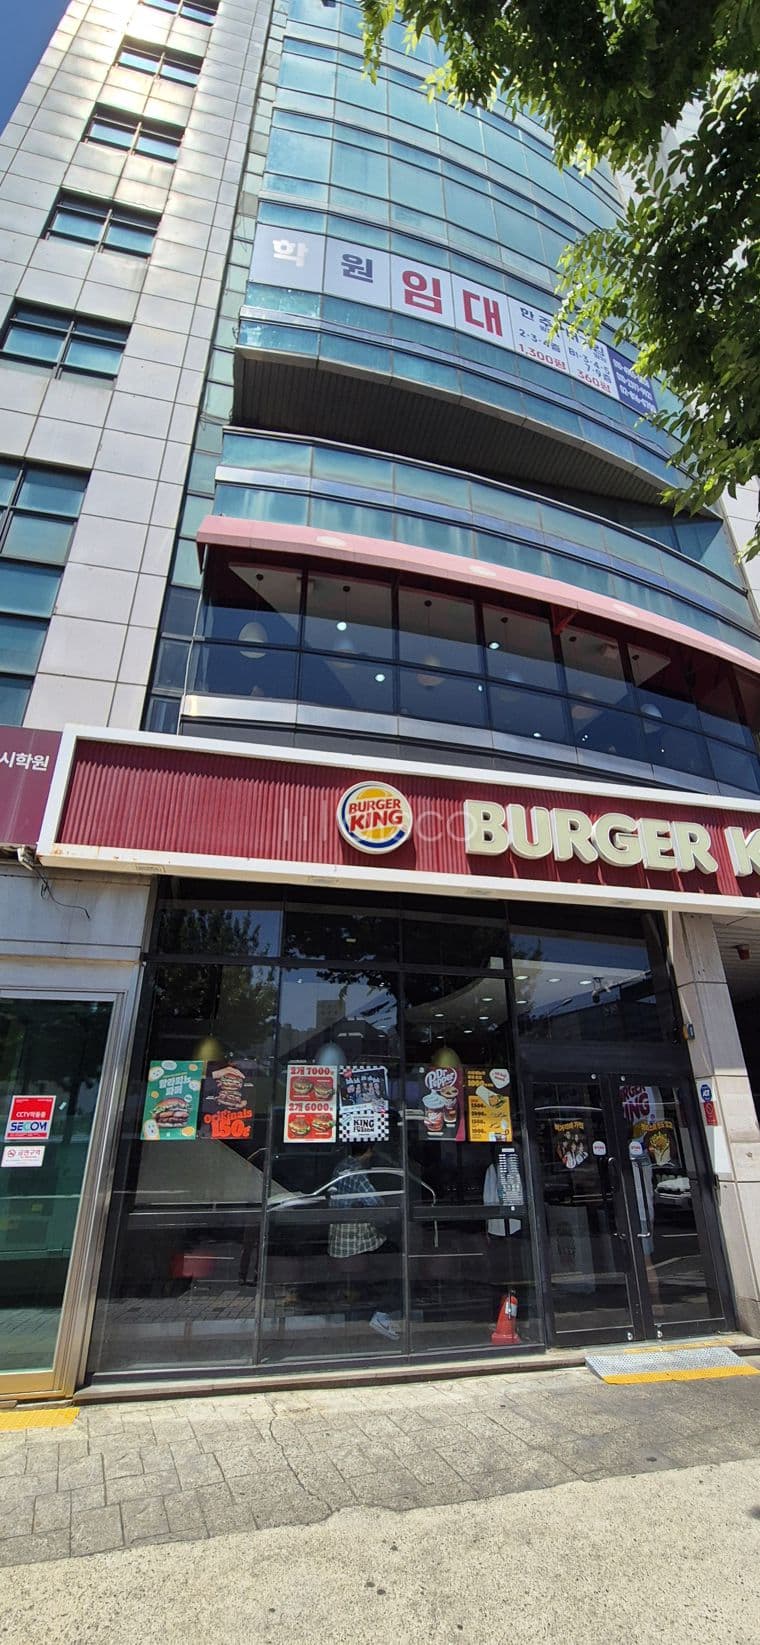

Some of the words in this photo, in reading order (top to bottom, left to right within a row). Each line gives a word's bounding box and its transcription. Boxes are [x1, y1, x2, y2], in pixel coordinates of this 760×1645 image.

[0, 751, 50, 771] 시학원
[348, 798, 401, 814] BURGER
[349, 810, 403, 832] KING
[463, 799, 718, 875] BURGER
[10, 1121, 47, 1131] SECOM
[353, 1119, 374, 1128] KING
